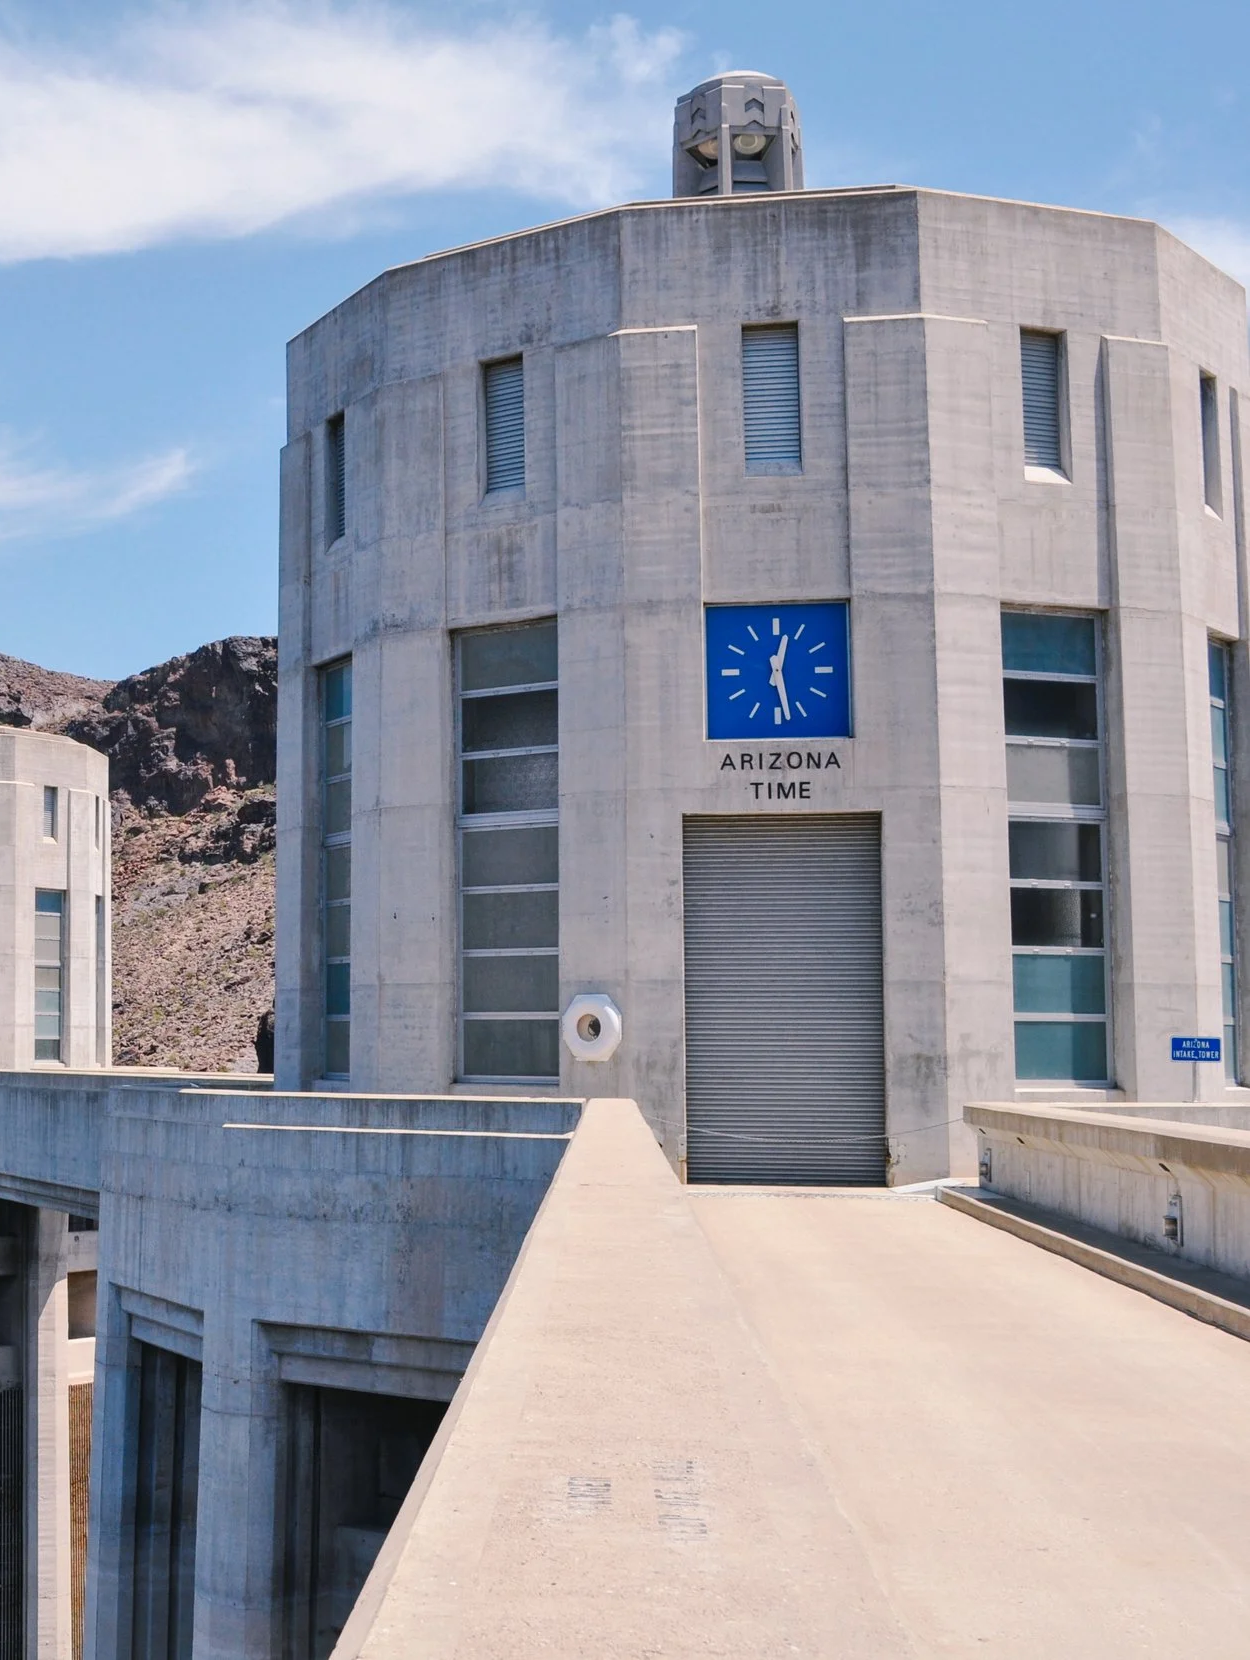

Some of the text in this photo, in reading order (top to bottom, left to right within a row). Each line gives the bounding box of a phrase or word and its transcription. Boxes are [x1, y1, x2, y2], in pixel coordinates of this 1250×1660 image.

[720, 751, 841, 771] ARIZONA
[750, 781, 811, 800] TIME
[1182, 1040, 1210, 1049] ARIZONA
[1173, 1050, 1219, 1059] INTAKE TOWER
